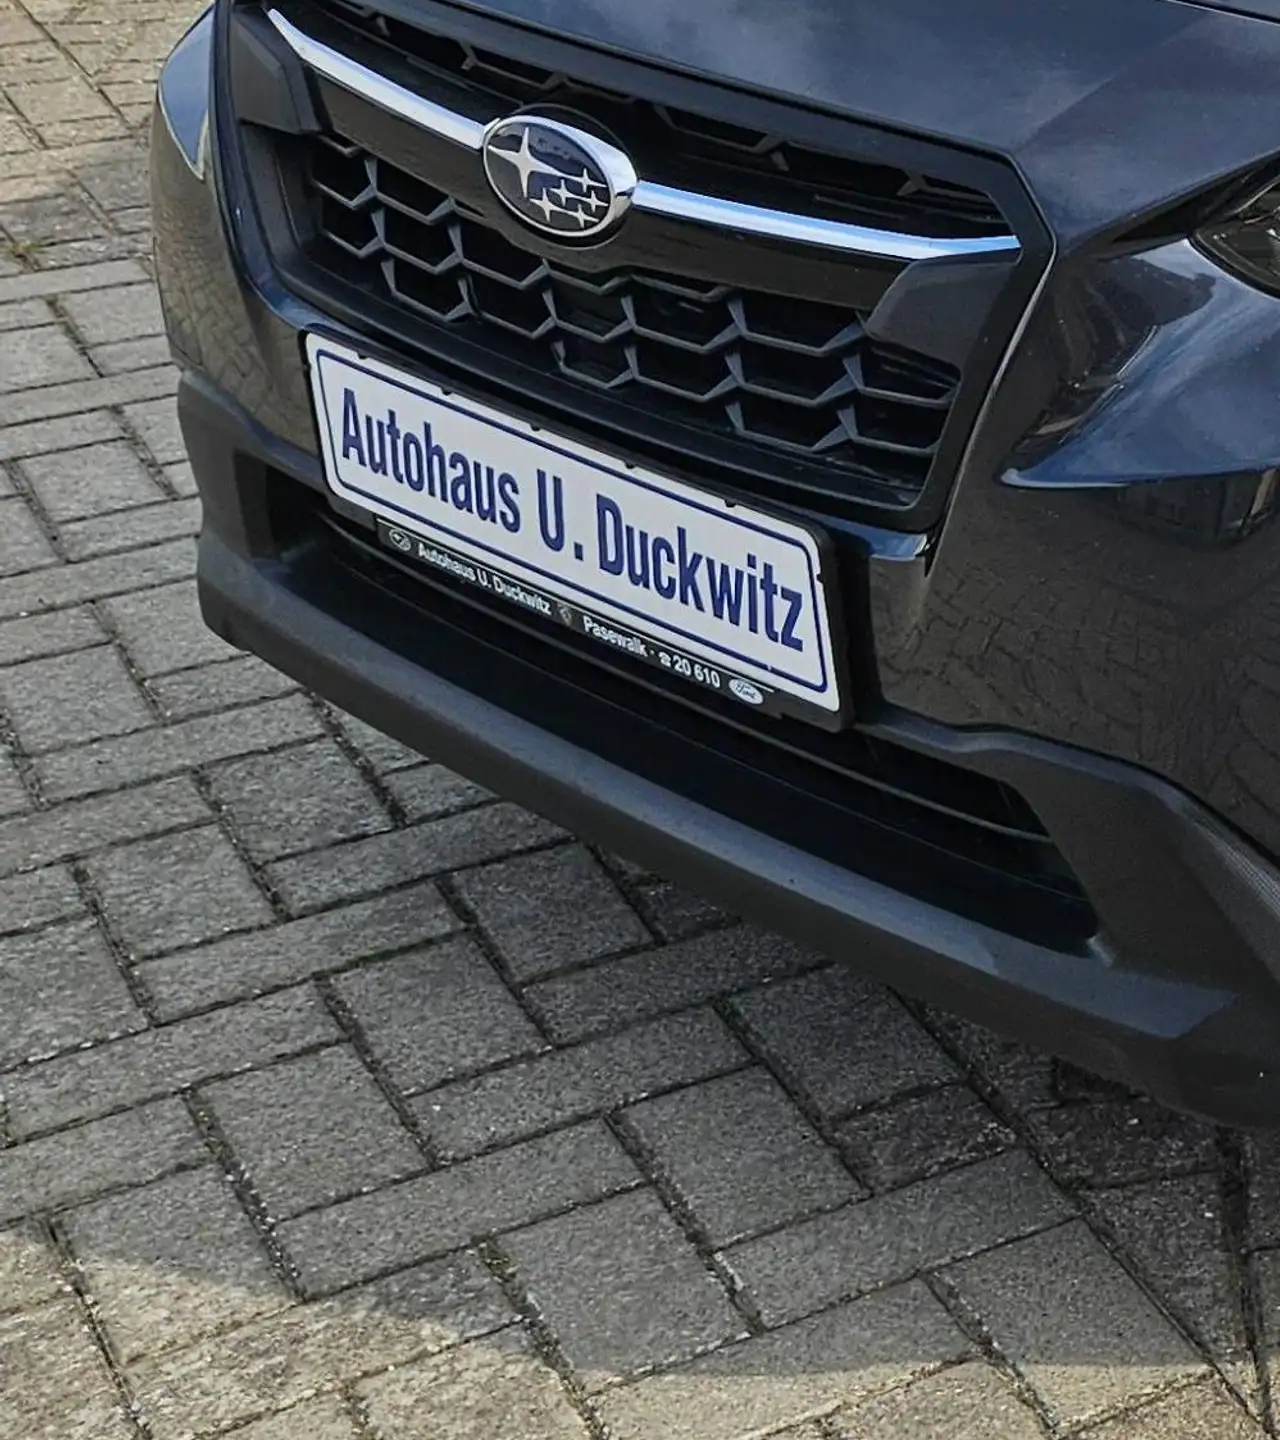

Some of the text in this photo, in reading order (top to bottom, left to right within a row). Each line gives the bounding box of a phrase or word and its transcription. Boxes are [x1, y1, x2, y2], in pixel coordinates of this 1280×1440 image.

[340, 386, 522, 534] Autohaus
[595, 492, 805, 654] Duckwitz
[417, 542, 552, 616] Autohaus U. Duckwitz
[582, 614, 721, 689] Pasewalk 20 610
